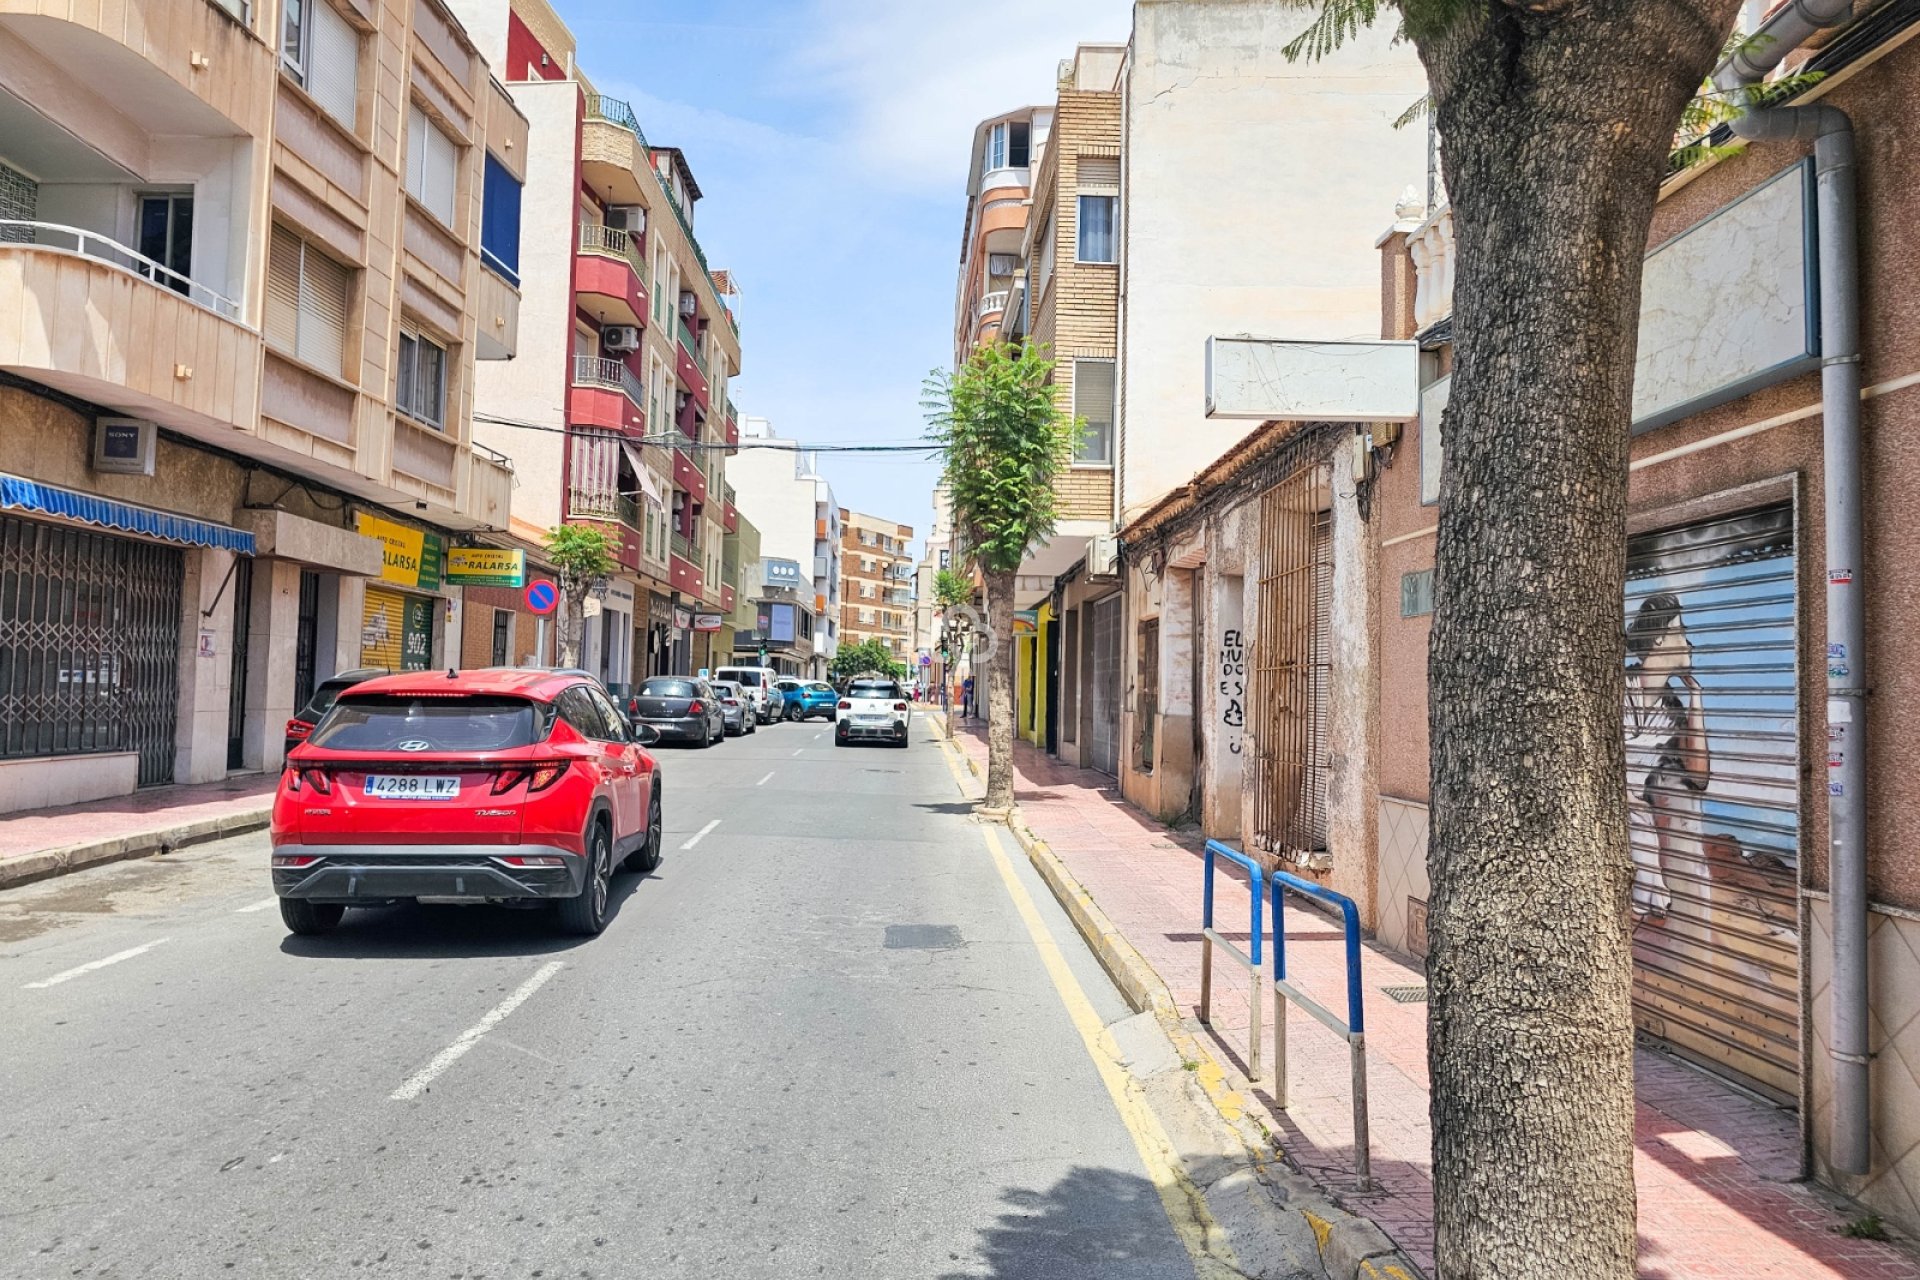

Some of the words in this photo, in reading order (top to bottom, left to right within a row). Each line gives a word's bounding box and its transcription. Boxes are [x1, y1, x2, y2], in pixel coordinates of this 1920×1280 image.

[382, 550, 416, 571] ALARSA
[468, 561, 518, 570] RALARSA
[407, 632, 426, 655] 902
[1223, 630, 1243, 647] EL
[376, 778, 418, 792] 4288
[424, 778, 456, 794] LWZ
